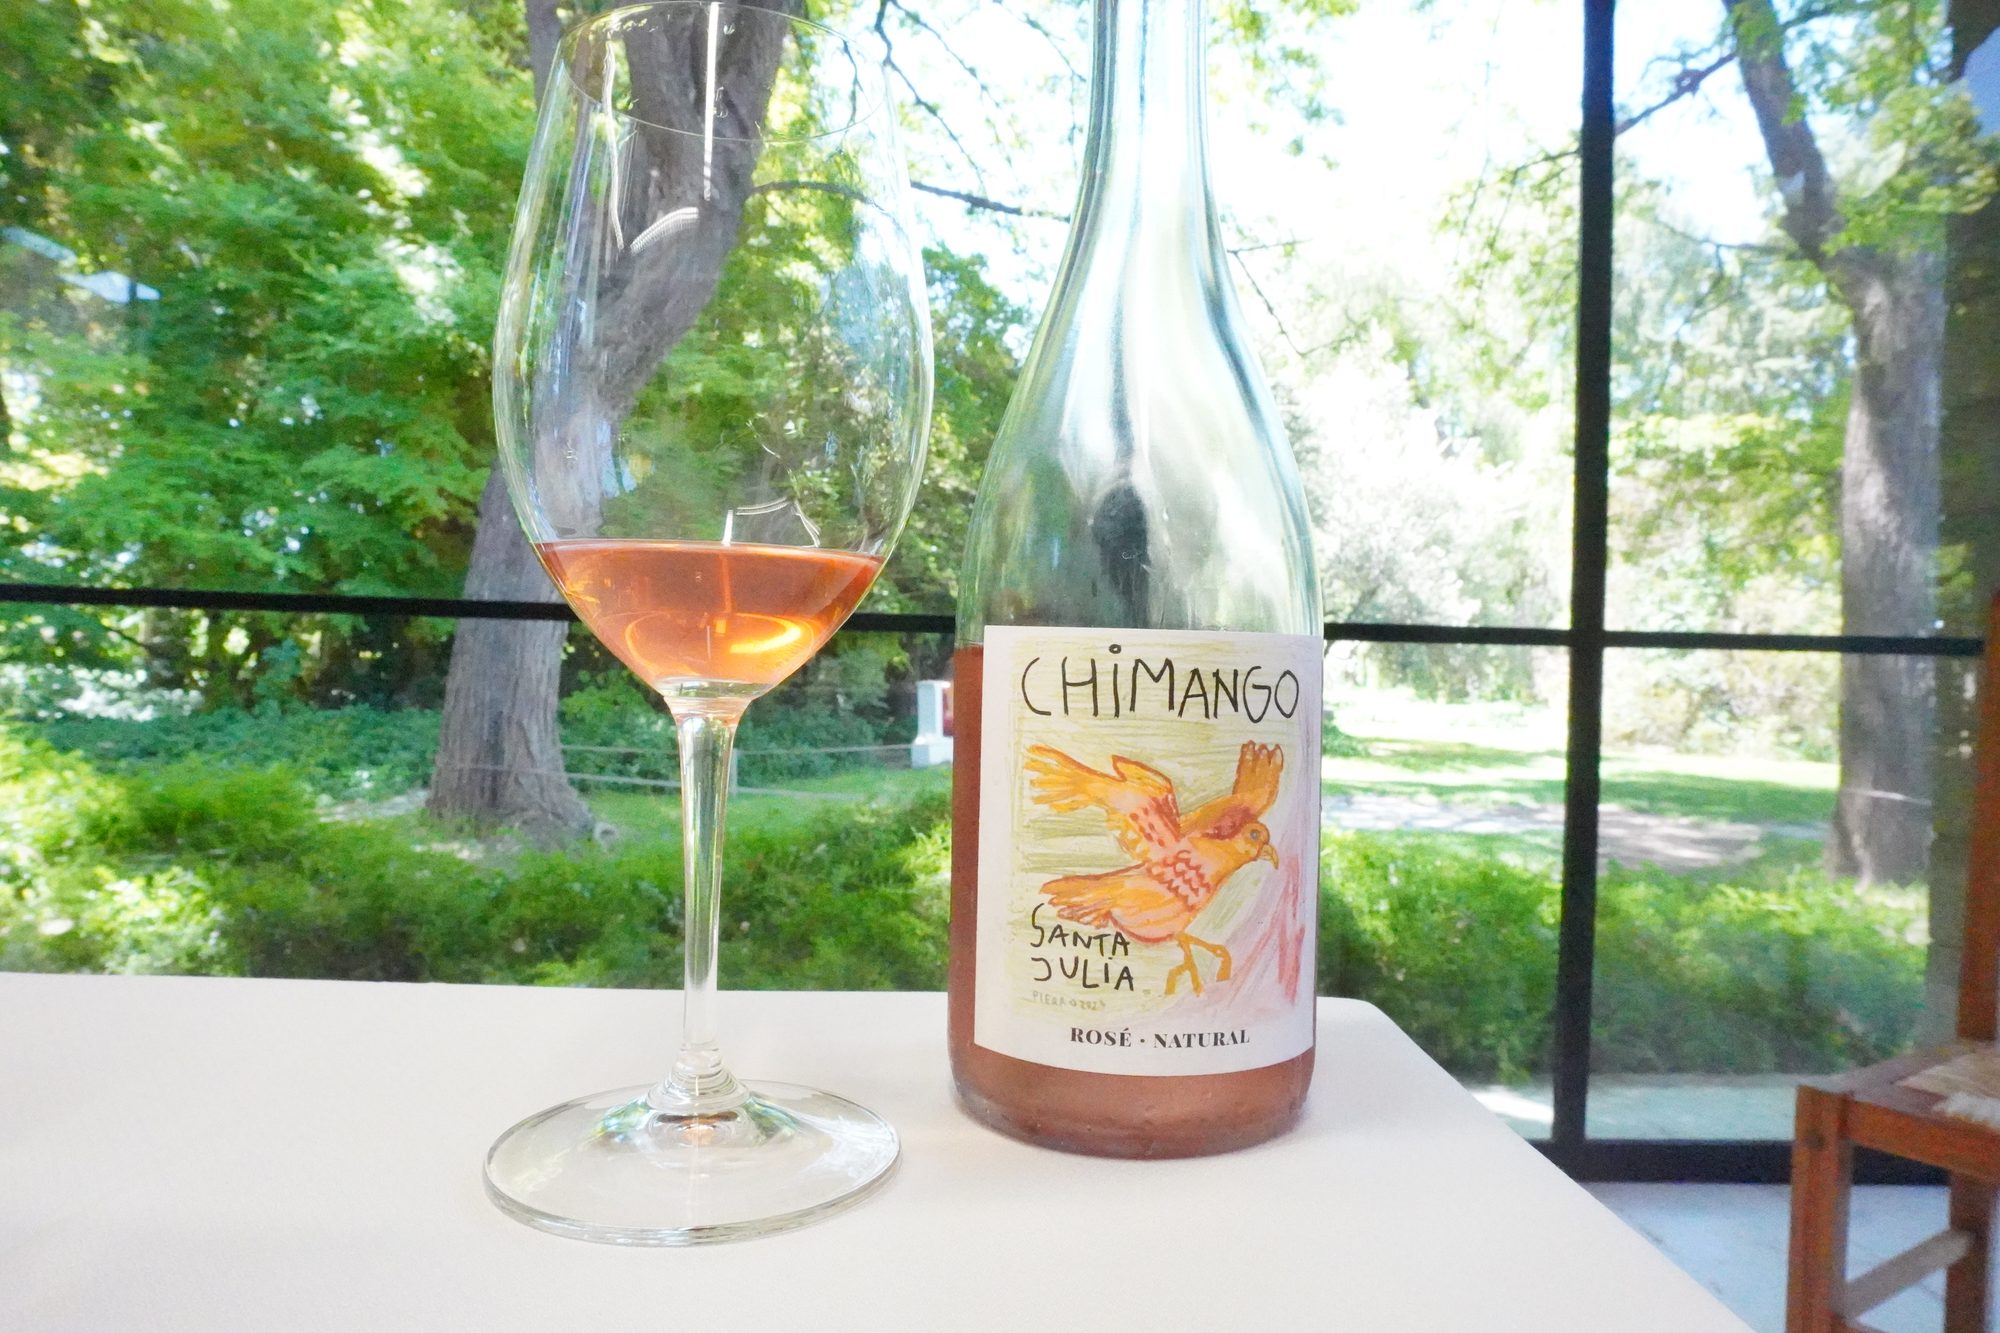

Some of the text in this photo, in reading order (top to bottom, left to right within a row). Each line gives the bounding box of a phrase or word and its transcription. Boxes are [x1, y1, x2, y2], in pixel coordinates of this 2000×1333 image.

[1030, 902, 1130, 957] SANTA
[1070, 1027, 1250, 1049] ROSÉ NATURAL
